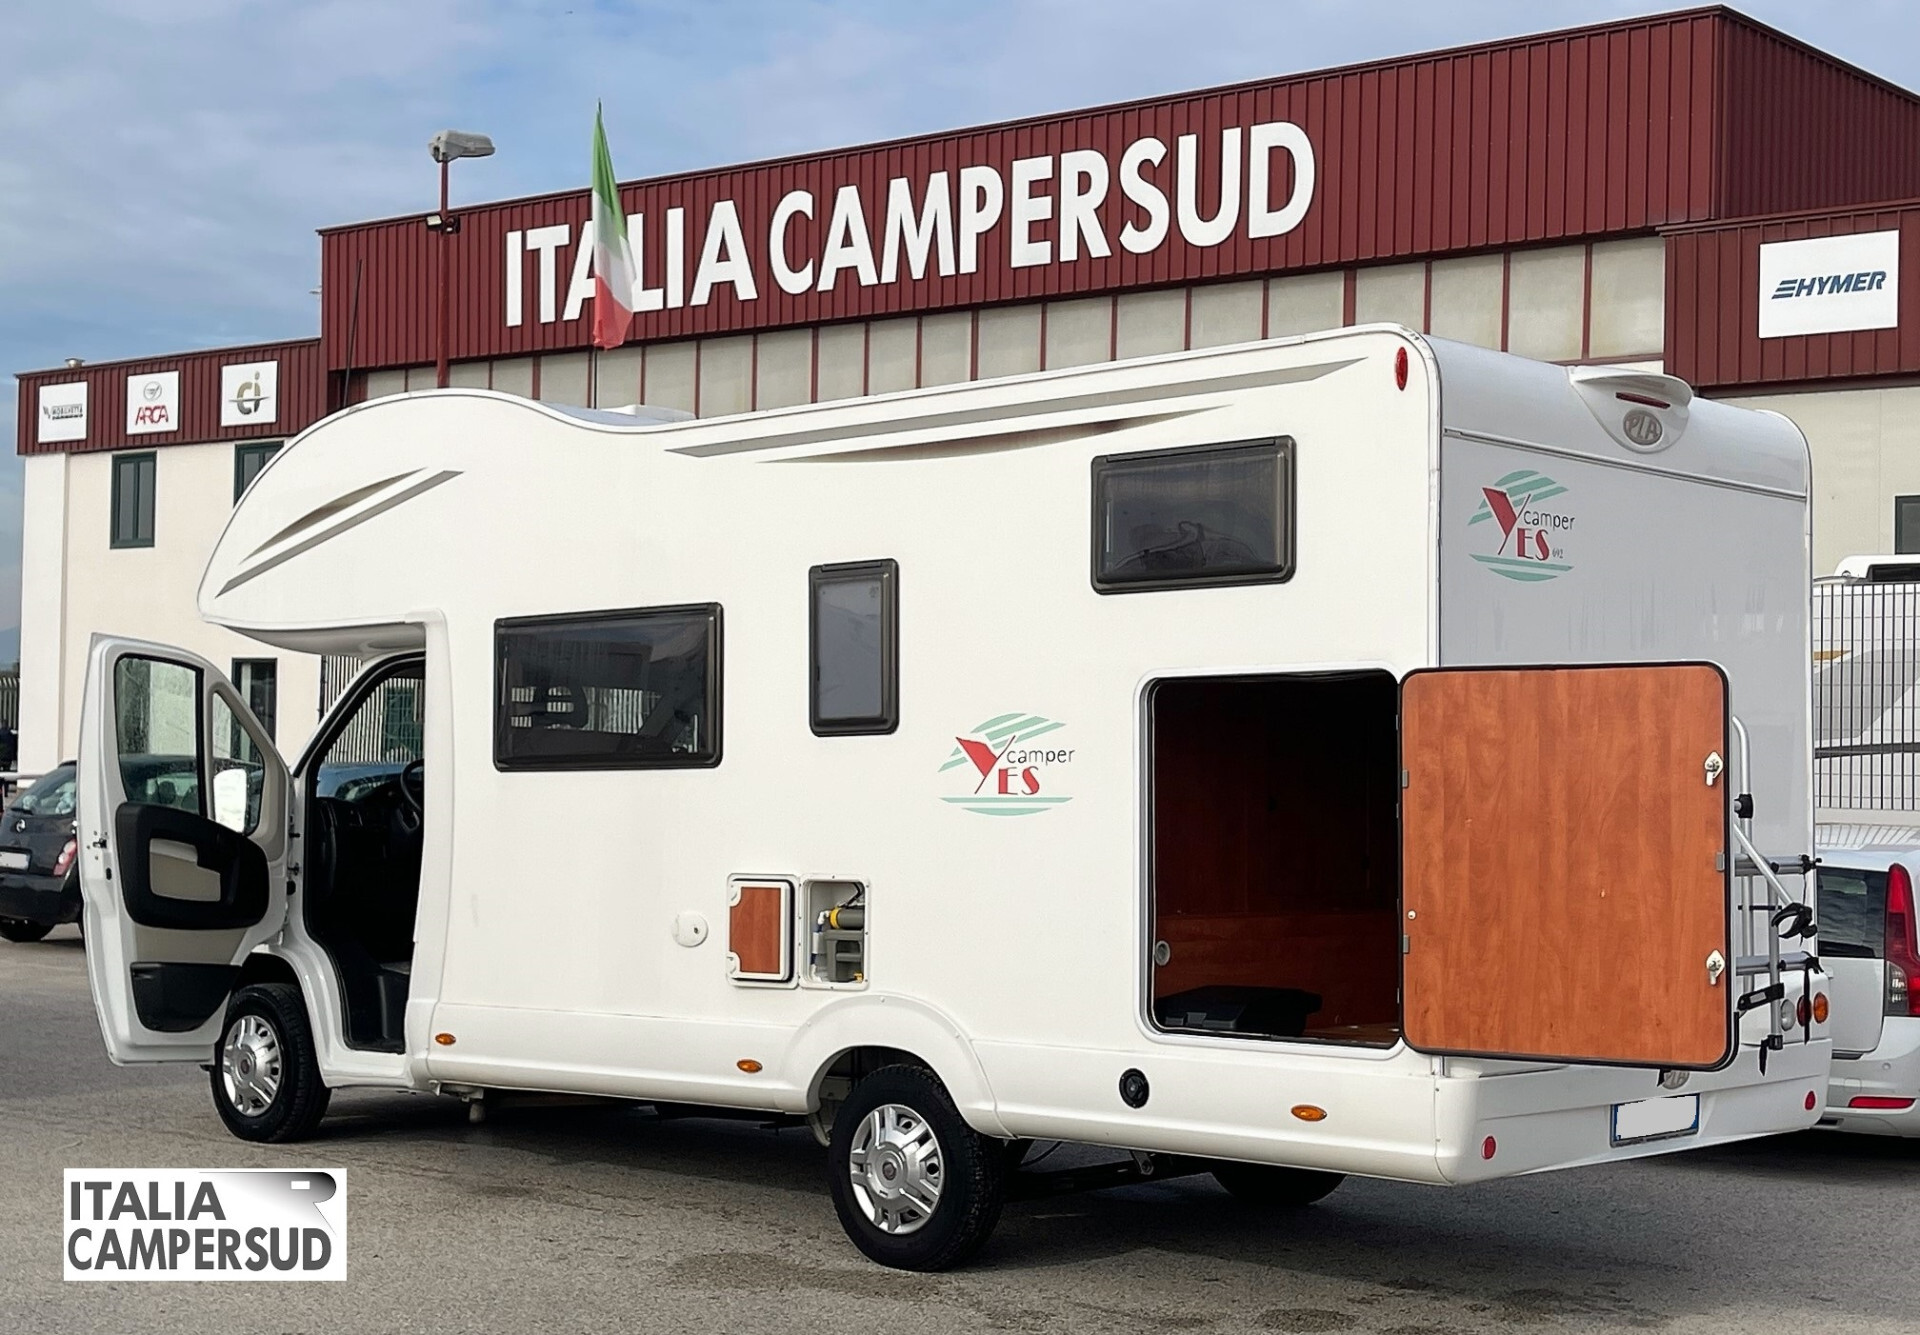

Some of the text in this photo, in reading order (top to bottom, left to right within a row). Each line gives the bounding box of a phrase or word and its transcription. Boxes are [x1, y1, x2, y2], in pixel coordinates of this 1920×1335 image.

[506, 122, 1316, 327] ITALIA CAMPERSUD
[1795, 270, 1887, 298] HYMER
[135, 405, 169, 425] ARCA
[1482, 487, 1550, 561] YES
[1524, 510, 1576, 531] camper
[955, 735, 1040, 795] YES
[1007, 749, 1075, 766] camper
